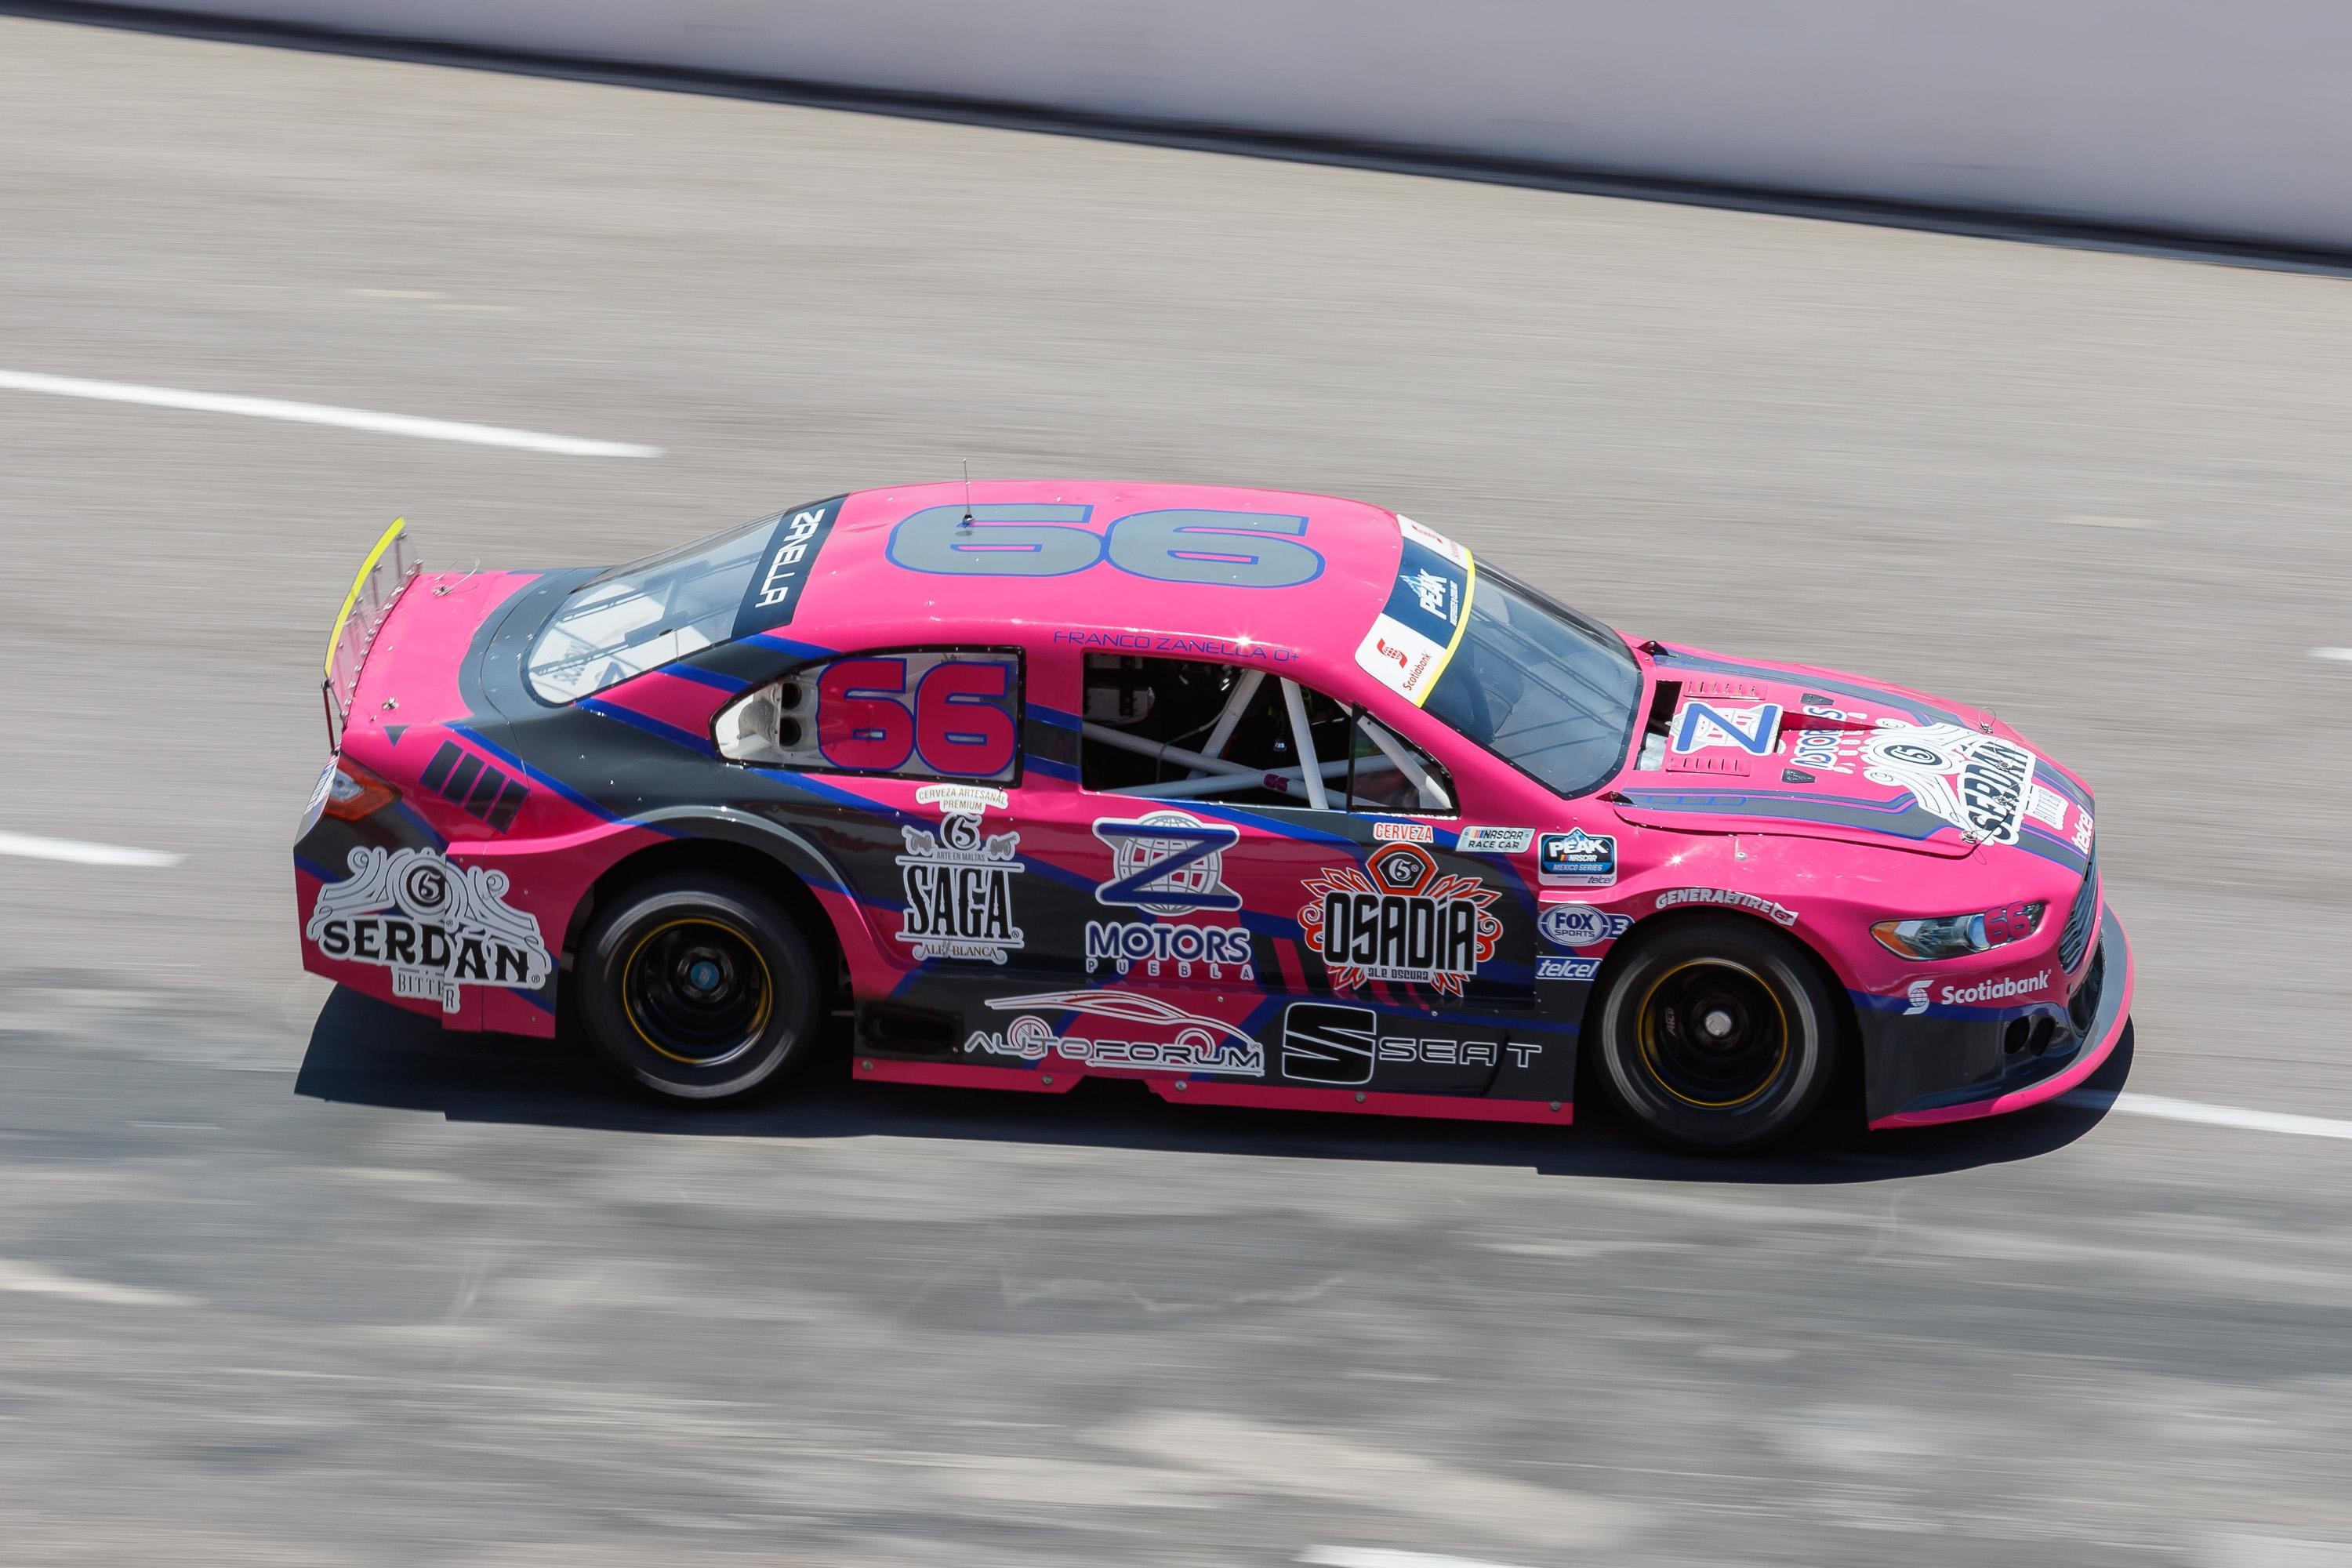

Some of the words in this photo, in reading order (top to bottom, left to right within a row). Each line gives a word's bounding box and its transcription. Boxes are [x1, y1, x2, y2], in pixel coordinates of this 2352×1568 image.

[885, 503, 1326, 588] 66
[755, 508, 826, 608] ZANELLA
[1419, 568, 1448, 621] PEAK
[1054, 631, 1150, 649] FRANCO
[1156, 637, 1267, 659] ZANELLA
[1403, 652, 1432, 691] Scotiabank
[816, 656, 1018, 777] 66
[919, 788, 956, 800] CERVEZA
[958, 788, 1006, 805] ARTESANAL
[943, 800, 983, 811] PREMIUM
[1374, 822, 1433, 842] CERVEZA
[1483, 829, 1524, 840] NASCAR
[2070, 804, 2094, 855] telcel
[936, 851, 952, 861] ARTE
[953, 852, 961, 861] EN
[961, 852, 986, 862] MALTAS
[1548, 840, 1610, 858] PEAK
[1569, 854, 1598, 862] NASCAR
[1552, 863, 1579, 872] MEXICO
[1588, 875, 1614, 884] telcel
[906, 865, 1012, 939] SAGA
[1554, 929, 1595, 938] SPORTS
[1555, 913, 1594, 931] FOX
[1982, 900, 2032, 946] 66
[952, 945, 1000, 961] BLANCA
[1087, 923, 1250, 964] MOTORS
[1086, 959, 1254, 980] PUEBLA
[1537, 959, 1602, 978] telcel
[397, 971, 455, 1010] BITTER
[1941, 970, 2049, 1006] Scotiabank
[964, 1030, 1261, 1070] AUTOFORUM
[1378, 1036, 1543, 1069] SEAT
